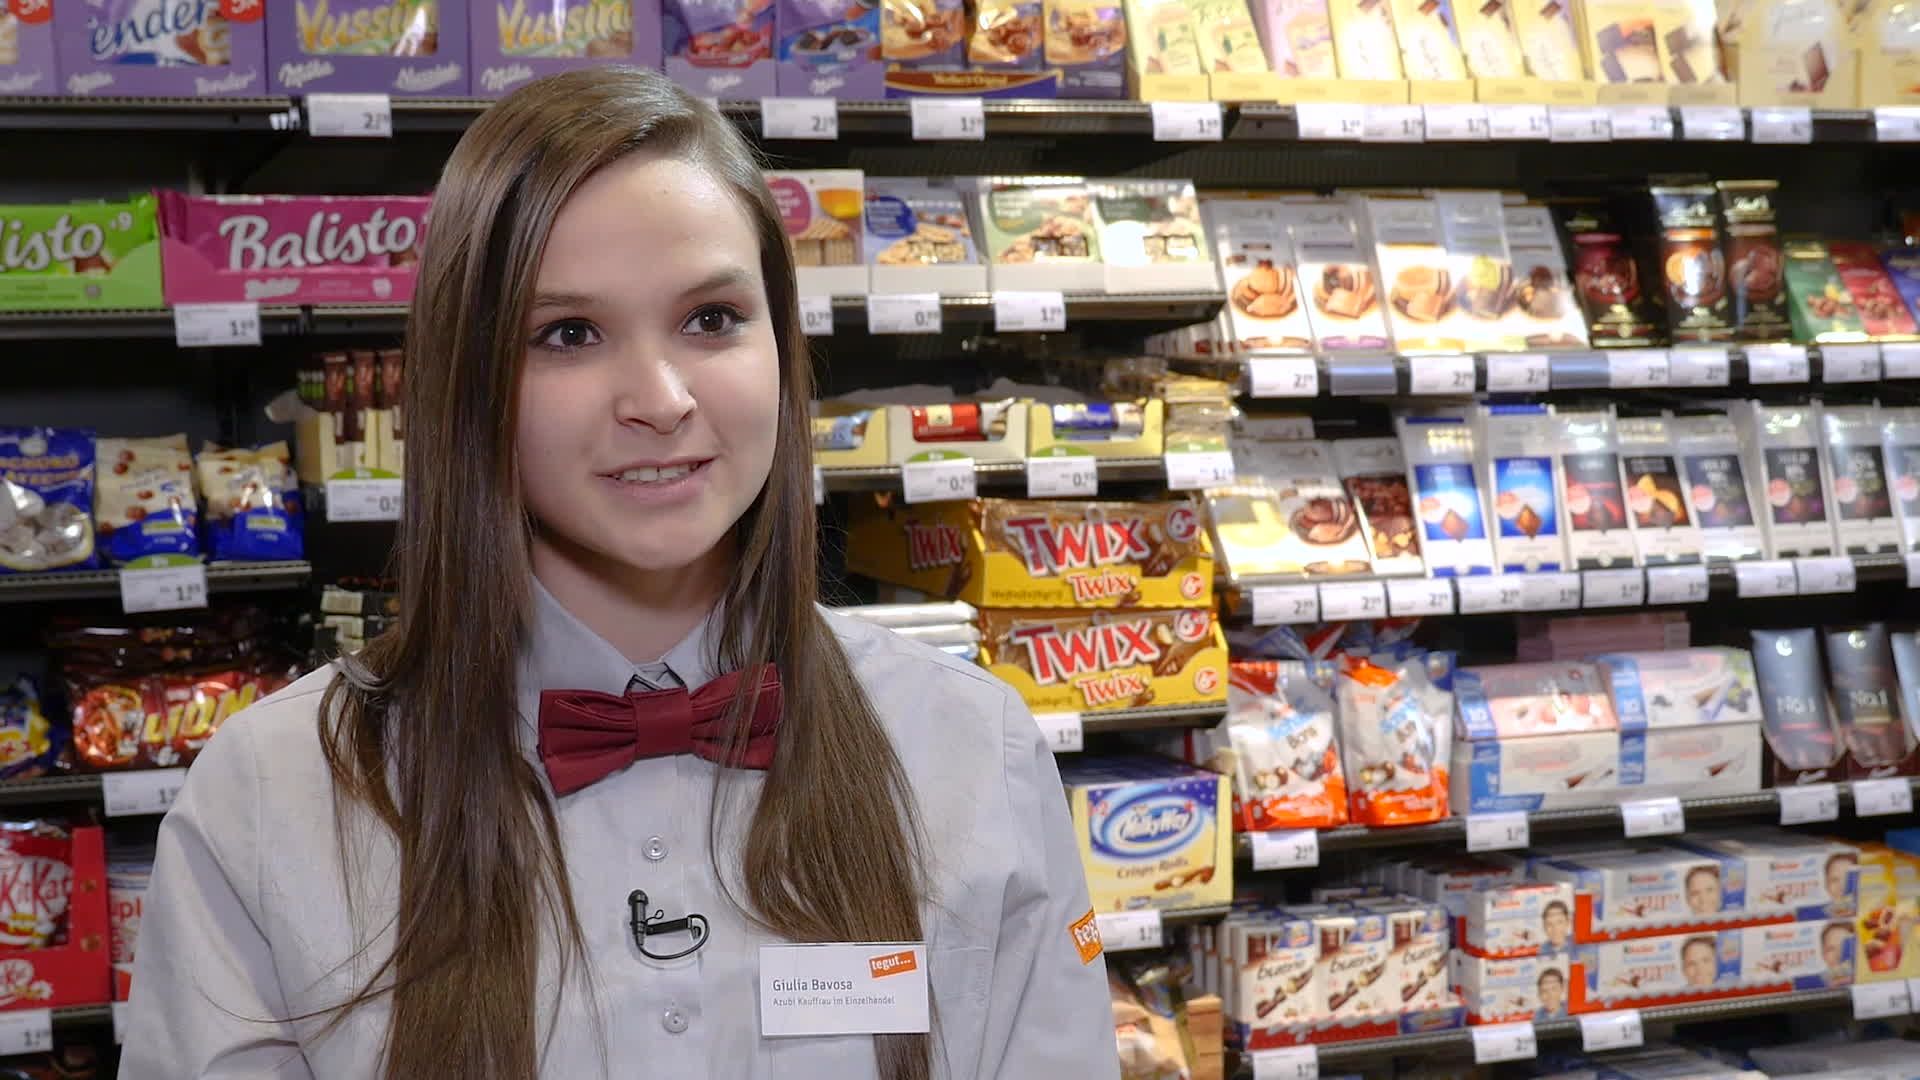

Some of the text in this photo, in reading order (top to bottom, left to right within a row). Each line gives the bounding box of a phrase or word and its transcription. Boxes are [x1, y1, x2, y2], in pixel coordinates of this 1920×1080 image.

[219, 207, 417, 273] Balisto
[772, 978, 853, 991] Giulia Bavosa
[772, 995, 896, 1007] Azubi Kauffrau im Einzelhandel
